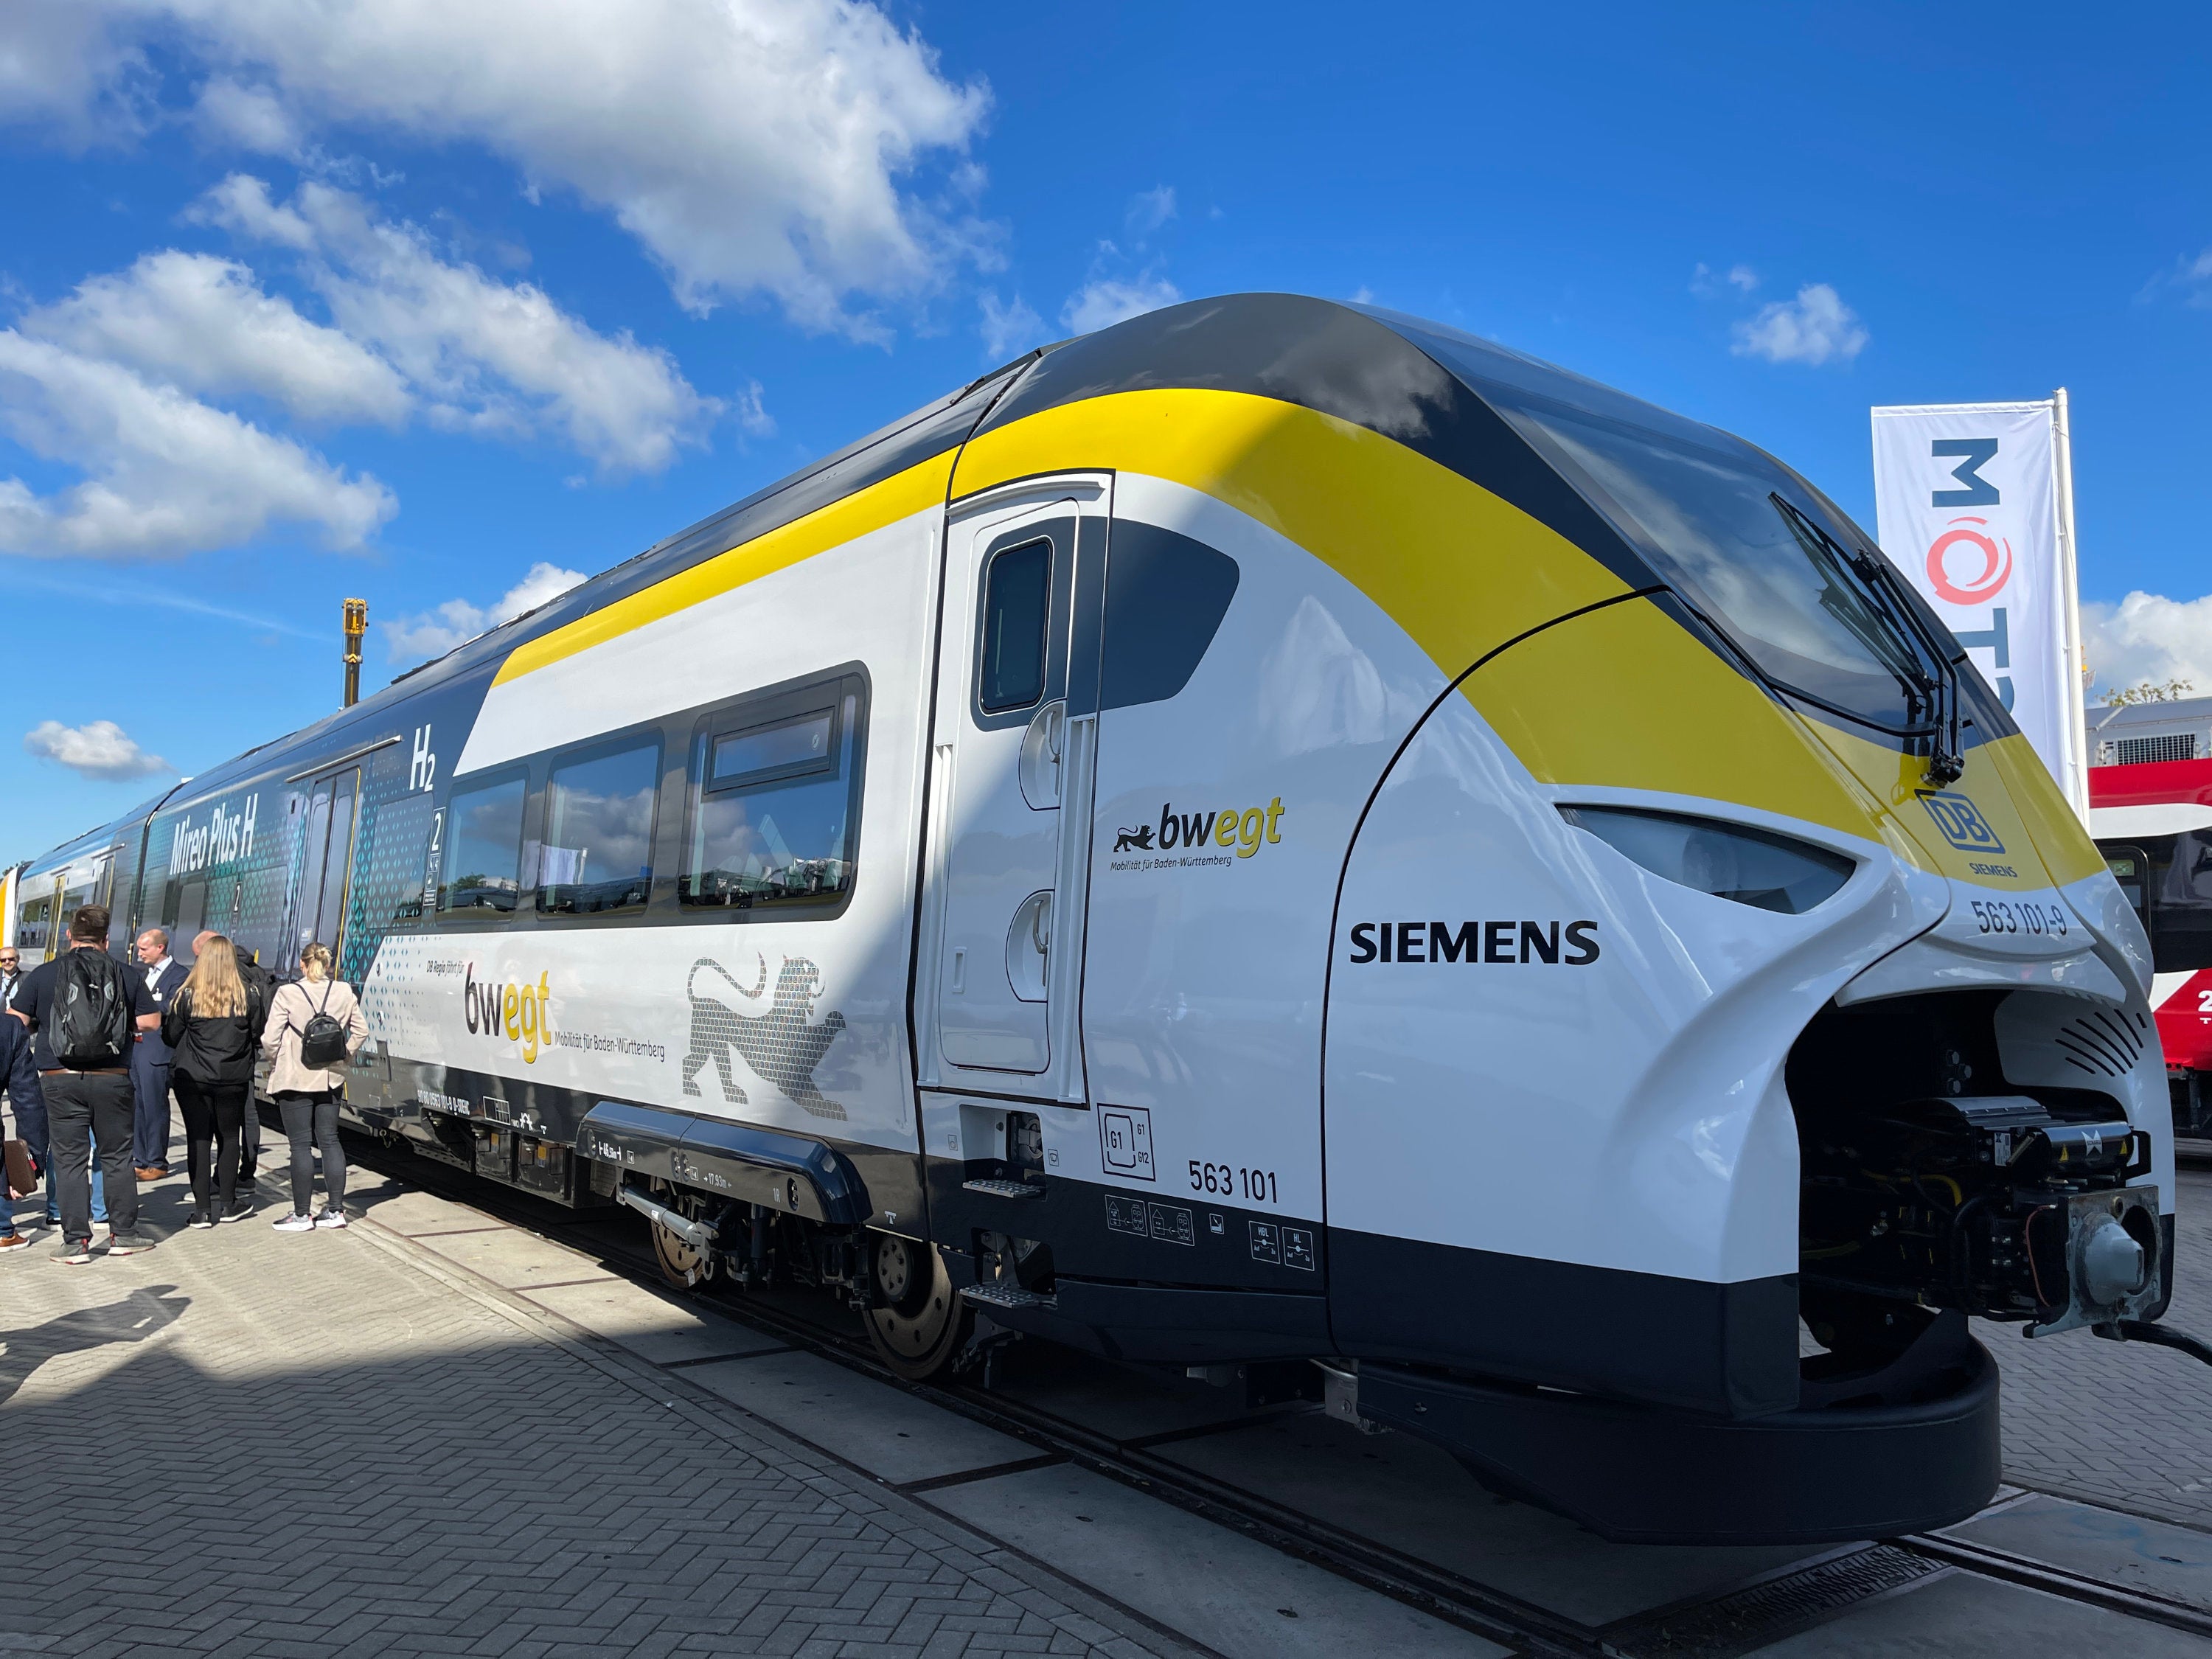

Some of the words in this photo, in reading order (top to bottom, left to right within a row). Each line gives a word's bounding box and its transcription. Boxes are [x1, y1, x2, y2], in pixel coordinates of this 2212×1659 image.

[1927, 438, 2014, 715] MOT
[170, 814, 207, 876] Mireo
[207, 801, 241, 867] Plus
[240, 793, 258, 859] H
[431, 812, 442, 851] 2
[1158, 796, 1285, 859] bwegt
[1927, 799, 1991, 842] DB
[1110, 860, 1141, 872] Mobilität
[1141, 859, 1154, 872] für
[1154, 855, 1232, 869] Baden-Württemberg
[1969, 863, 2018, 877] SIEMENS
[1971, 901, 2017, 933] 563
[2015, 902, 2067, 936] 101-9
[1350, 920, 1601, 966] SIEMENS
[426, 960, 434, 973] DB
[433, 960, 446, 976] Regio
[456, 960, 465, 978] für
[465, 961, 552, 1064] bwegt
[555, 1031, 582, 1048] Mobilität
[582, 1033, 593, 1053] für
[594, 1034, 665, 1062] Baden-Württemberg
[1110, 1130, 1122, 1150] G1
[1137, 1124, 1145, 1135] G1
[1189, 1160, 1233, 1196] 563
[1239, 1168, 1277, 1203] 101
[1258, 1226, 1270, 1237] HBL
[1293, 1233, 1301, 1244] HL
